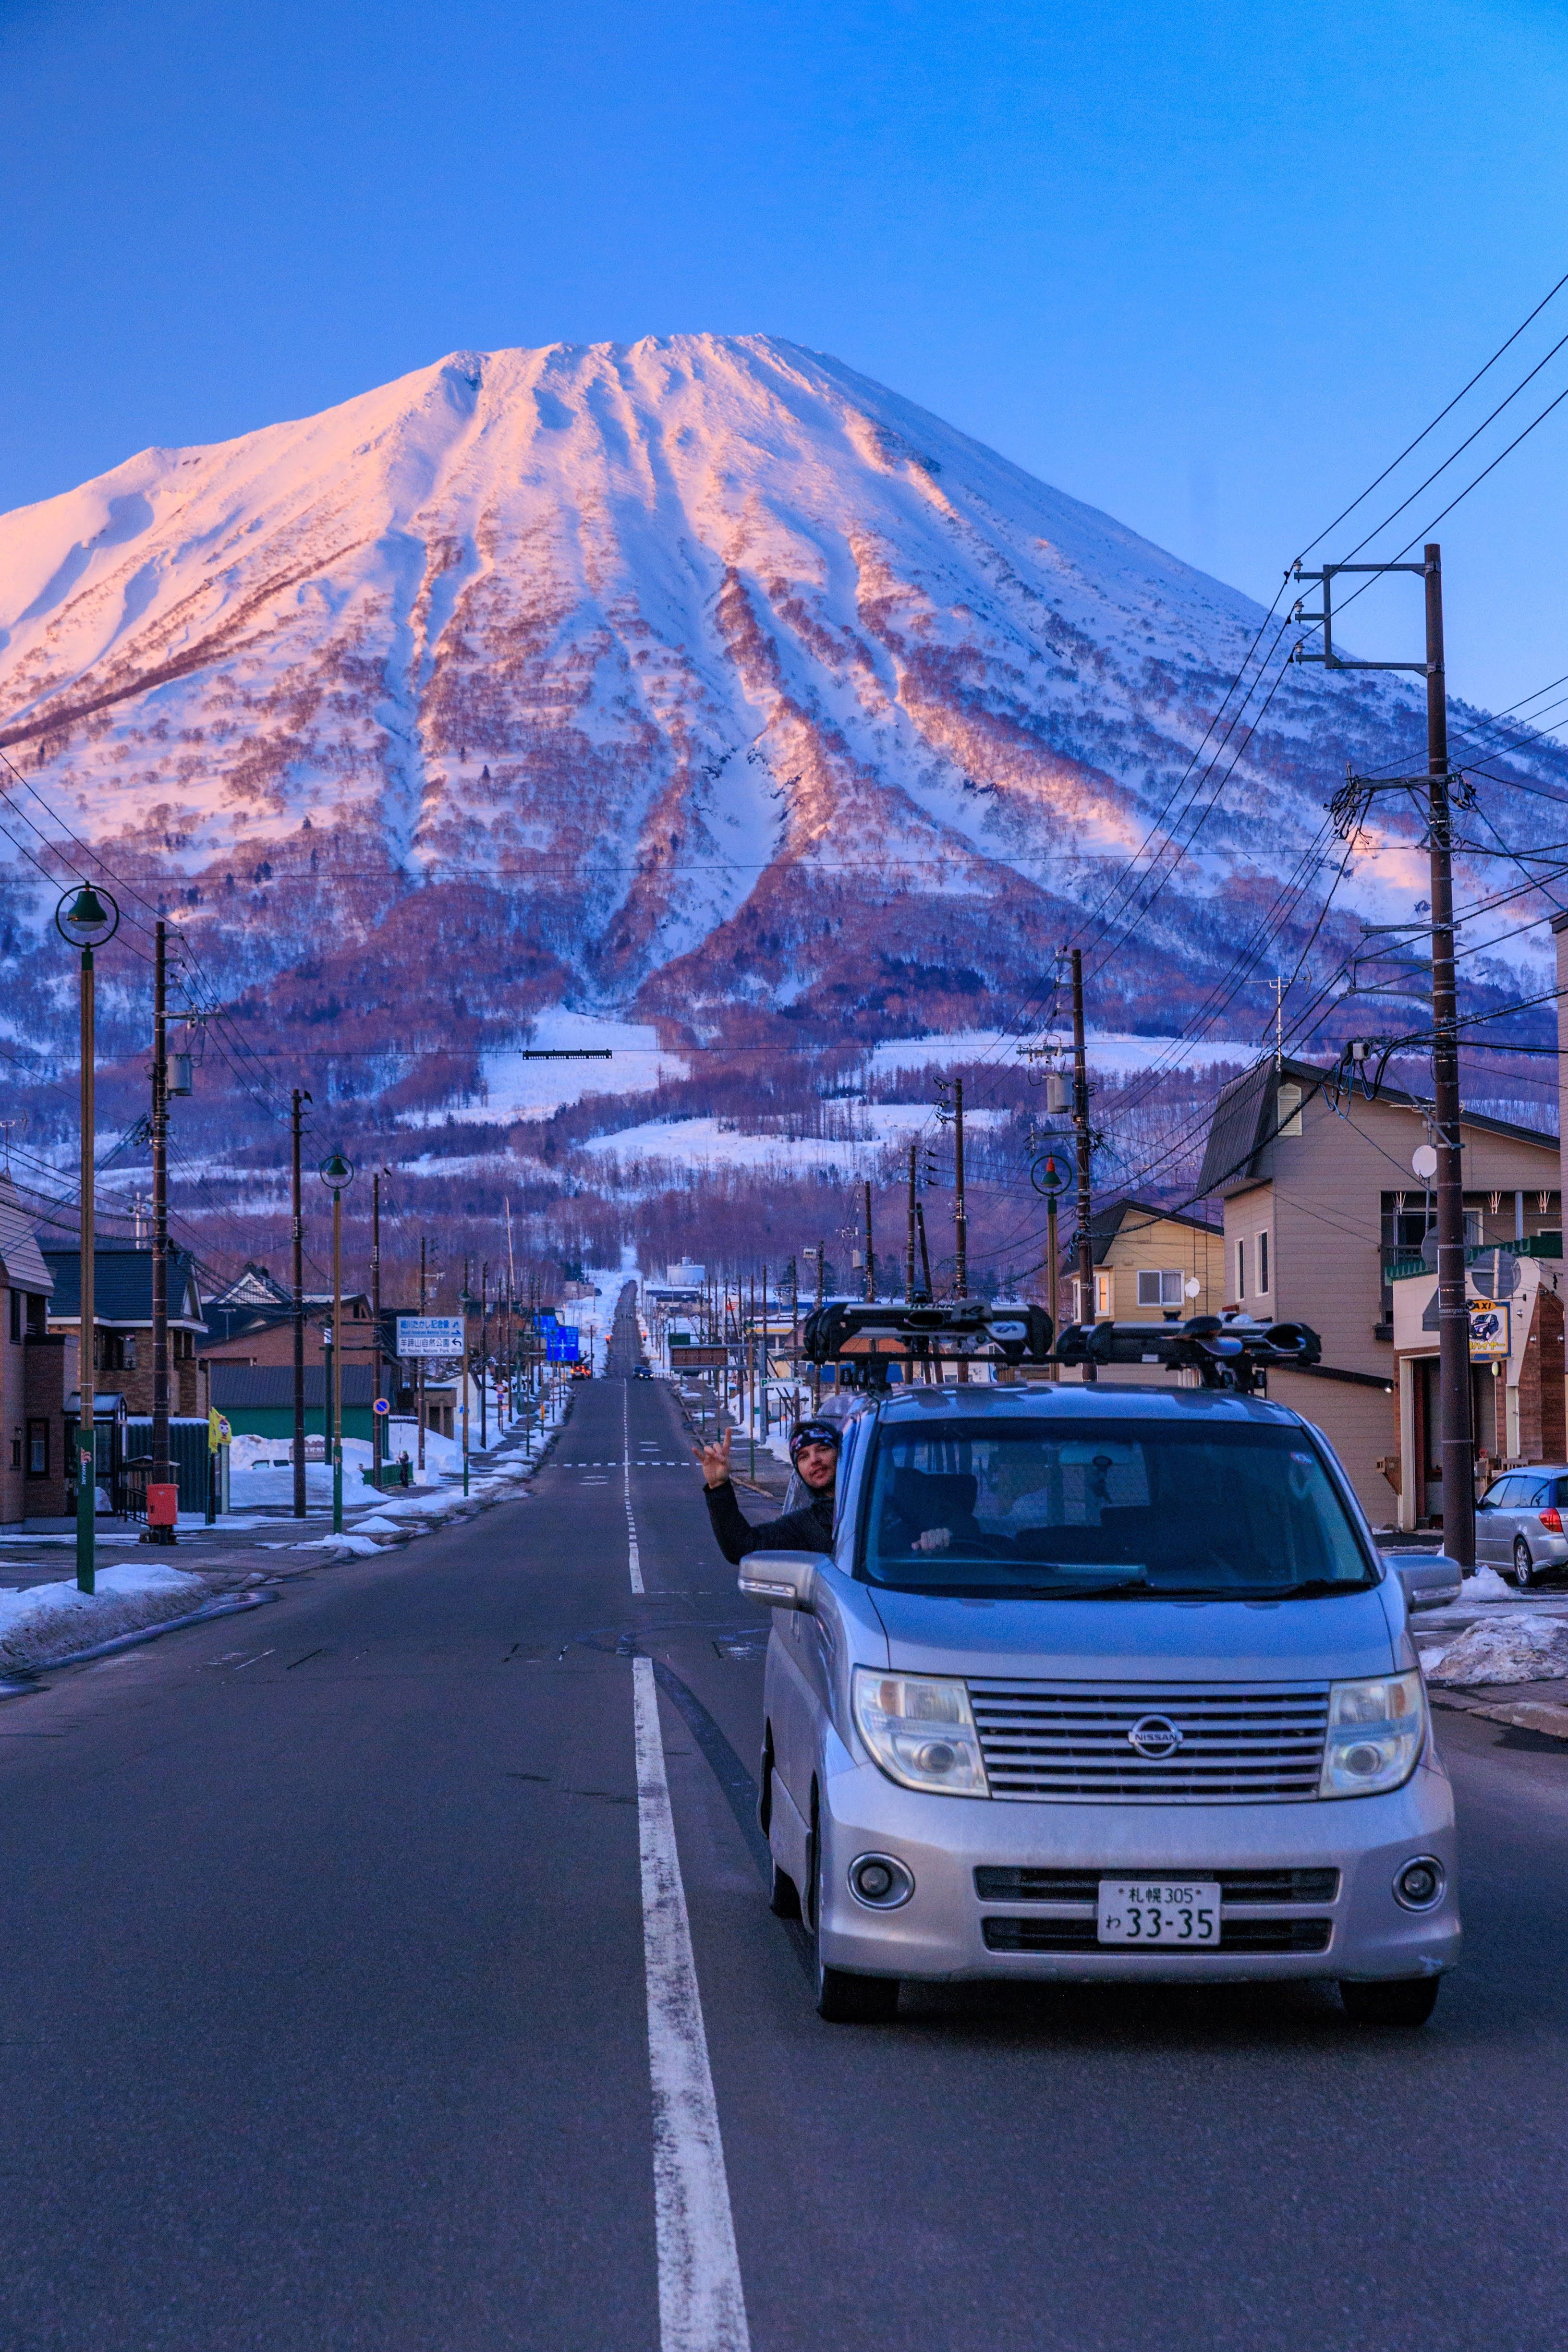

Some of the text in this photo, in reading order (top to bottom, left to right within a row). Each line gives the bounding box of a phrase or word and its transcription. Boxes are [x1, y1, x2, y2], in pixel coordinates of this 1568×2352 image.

[1129, 1888, 1193, 1903] 札幌 305
[1106, 1907, 1213, 1939] わ 33-35
